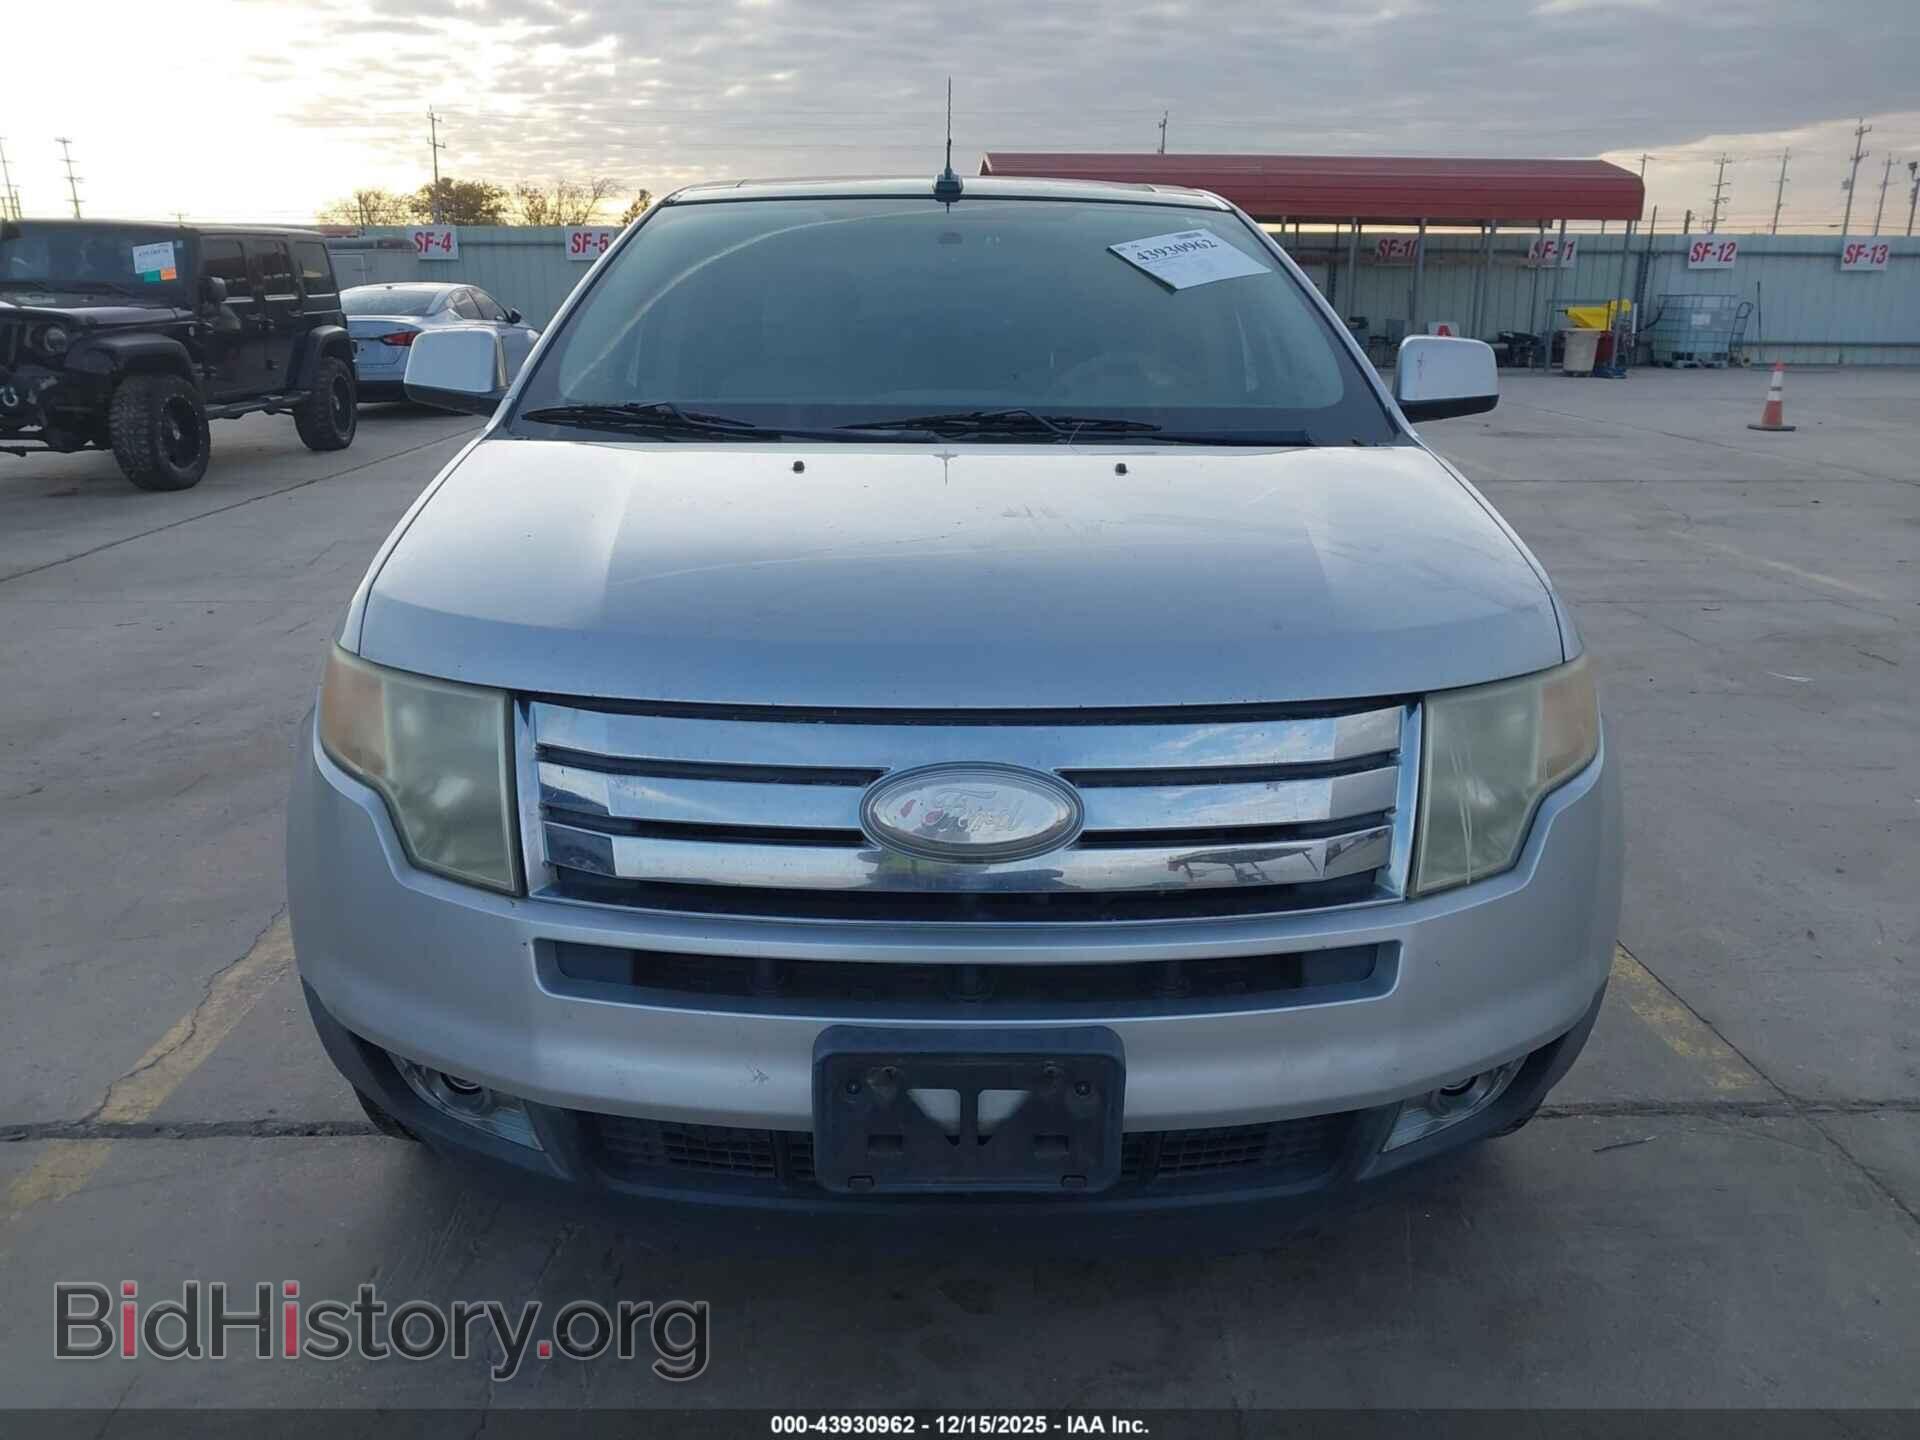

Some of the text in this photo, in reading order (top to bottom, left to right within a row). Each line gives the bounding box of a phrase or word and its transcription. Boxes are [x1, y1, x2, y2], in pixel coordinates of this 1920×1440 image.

[414, 232, 452, 253] SF-4
[571, 232, 609, 254] SF-5
[1135, 239, 1218, 261] 43930962
[1690, 242, 1736, 263] SF-12
[1843, 244, 1889, 264] SF-13
[926, 788, 1024, 832] Ford
